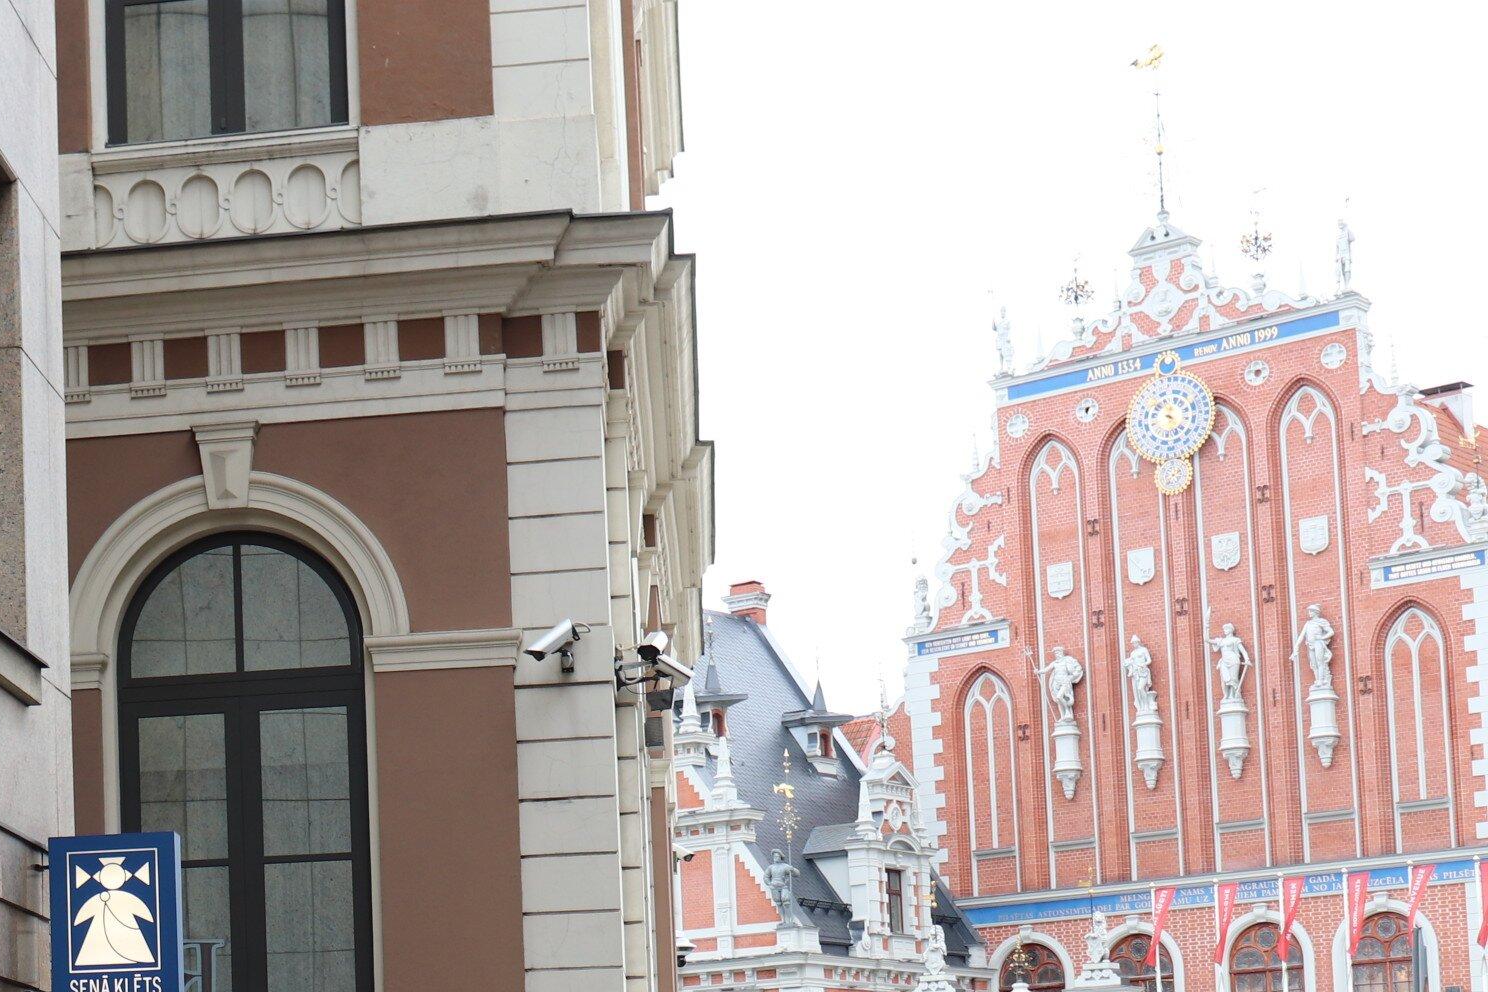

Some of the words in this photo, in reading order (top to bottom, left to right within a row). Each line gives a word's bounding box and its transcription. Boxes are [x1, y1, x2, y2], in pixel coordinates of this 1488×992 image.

[1221, 333, 1251, 351] ANNO
[1254, 327, 1278, 343] 1999
[1087, 364, 1114, 382] ANNO
[1118, 357, 1141, 375] 1334
